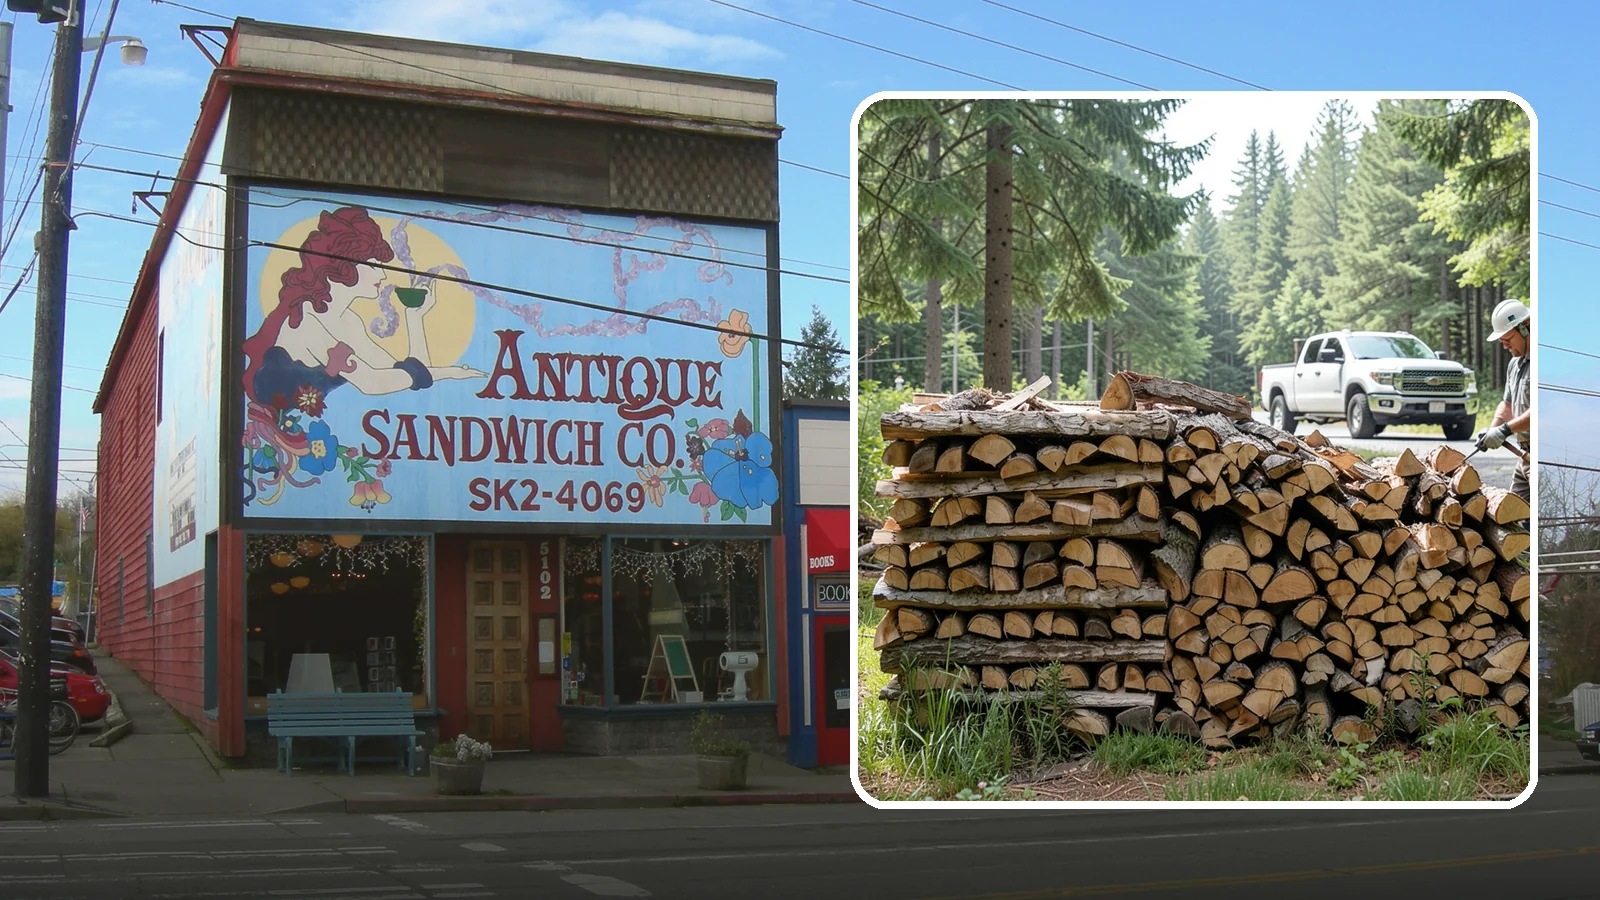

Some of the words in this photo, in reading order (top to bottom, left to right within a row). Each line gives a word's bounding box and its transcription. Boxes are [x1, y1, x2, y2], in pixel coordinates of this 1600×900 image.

[476, 329, 723, 421] ANTIQUE
[361, 409, 604, 466] SANDWICH
[617, 422, 685, 468] CO.
[468, 477, 647, 513] SK2-4069
[539, 541, 552, 600] 5102
[809, 555, 835, 568] BOOKS
